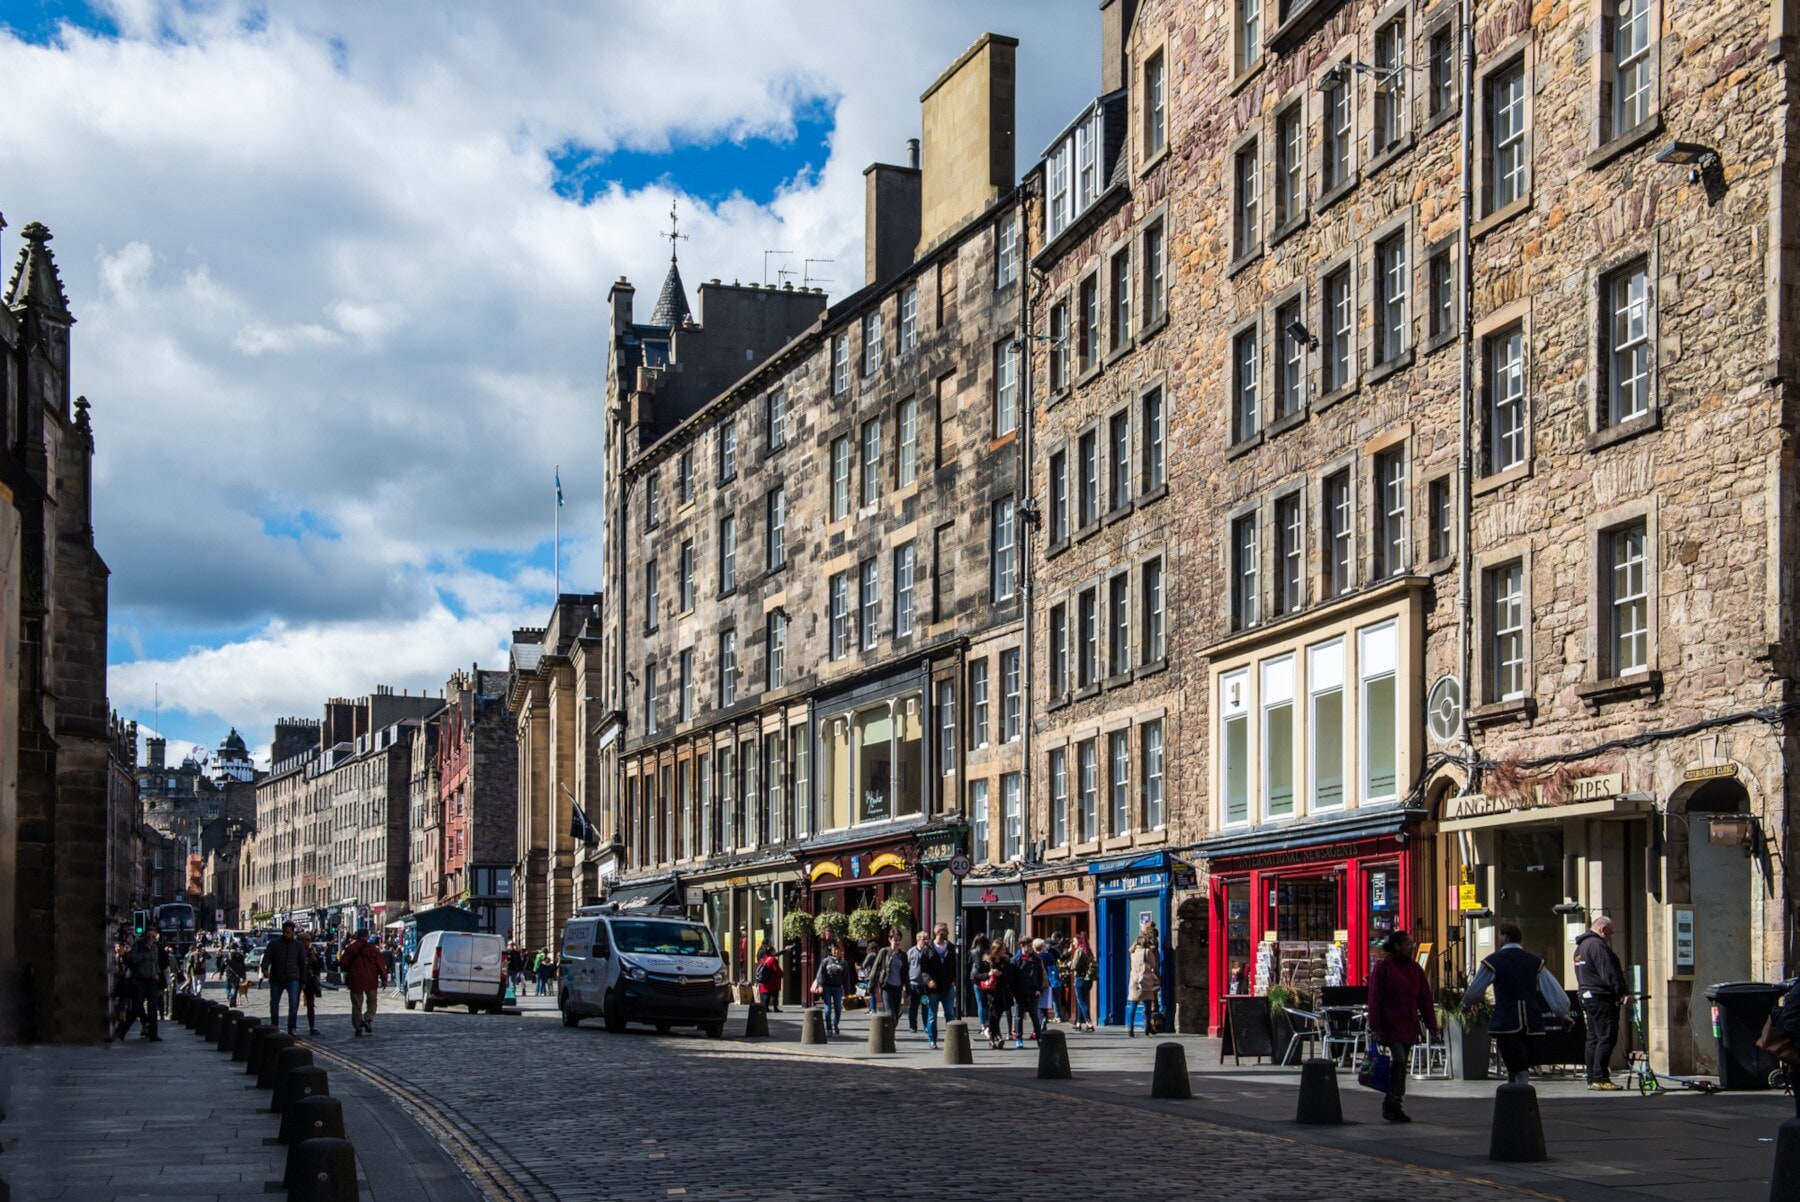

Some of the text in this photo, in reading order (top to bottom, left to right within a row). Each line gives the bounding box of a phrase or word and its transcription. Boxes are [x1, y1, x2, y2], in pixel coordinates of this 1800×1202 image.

[1716, 764, 1733, 775] CLOSE
[1239, 845, 1359, 869] INTERNATIONAL NEWSAGENTS
[953, 860, 968, 870] 20
